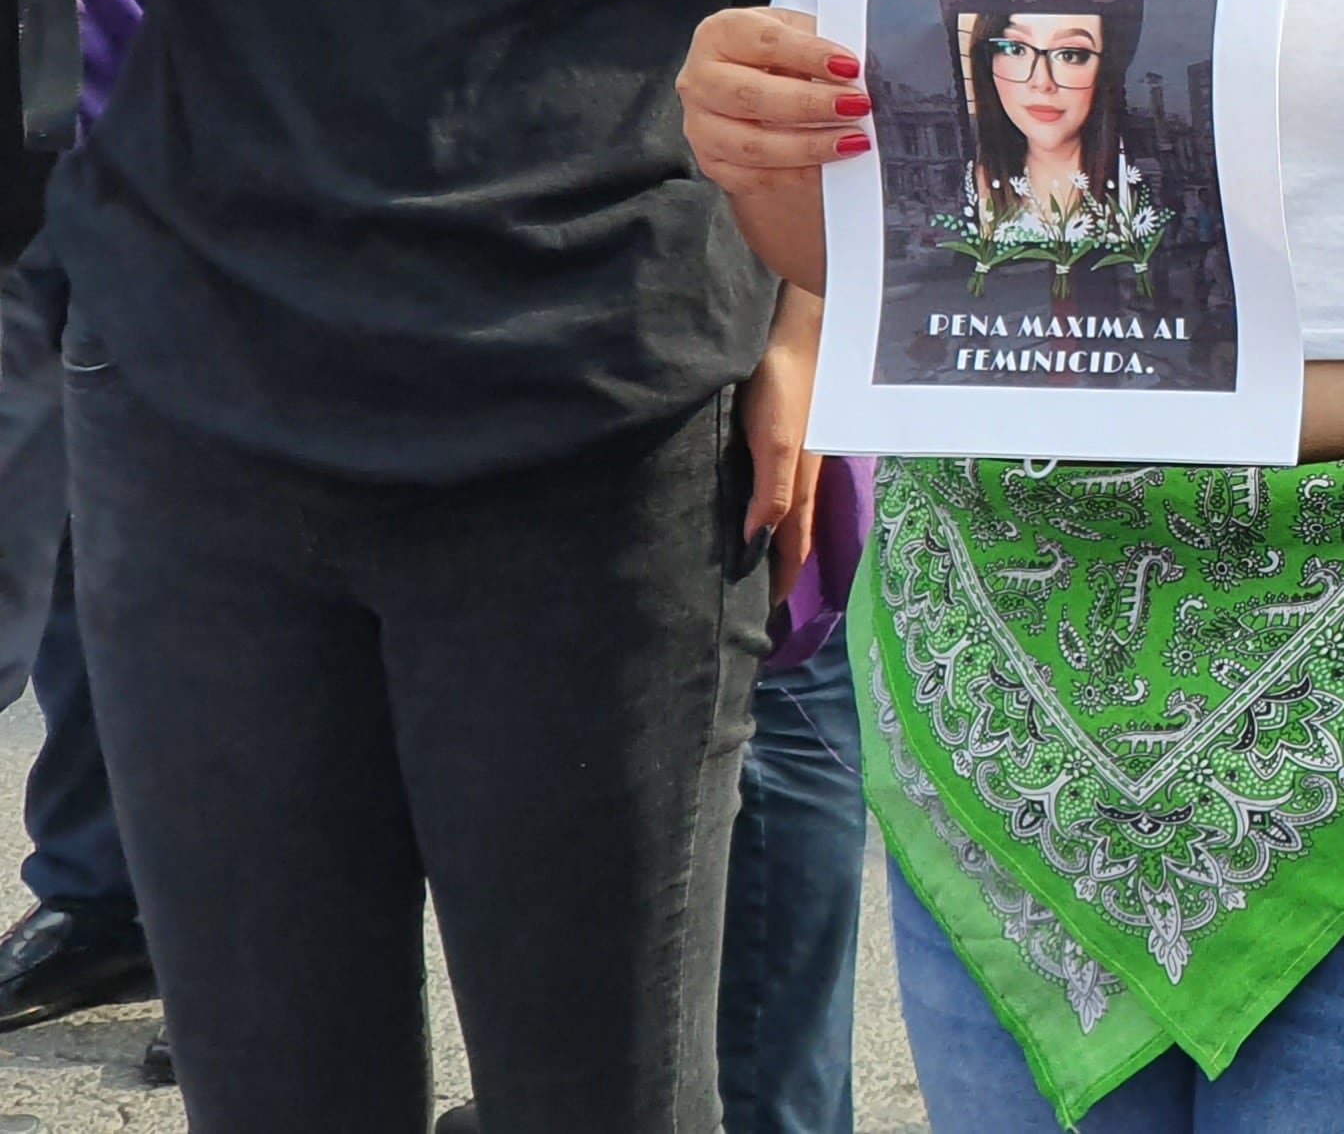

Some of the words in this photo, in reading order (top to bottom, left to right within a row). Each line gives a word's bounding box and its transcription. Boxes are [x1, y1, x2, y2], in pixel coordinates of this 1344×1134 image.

[929, 314, 1009, 337] PENA
[1017, 316, 1145, 340] MAXIMA
[1153, 318, 1190, 340] AL
[956, 349, 1155, 374] FEMINICIDA.
